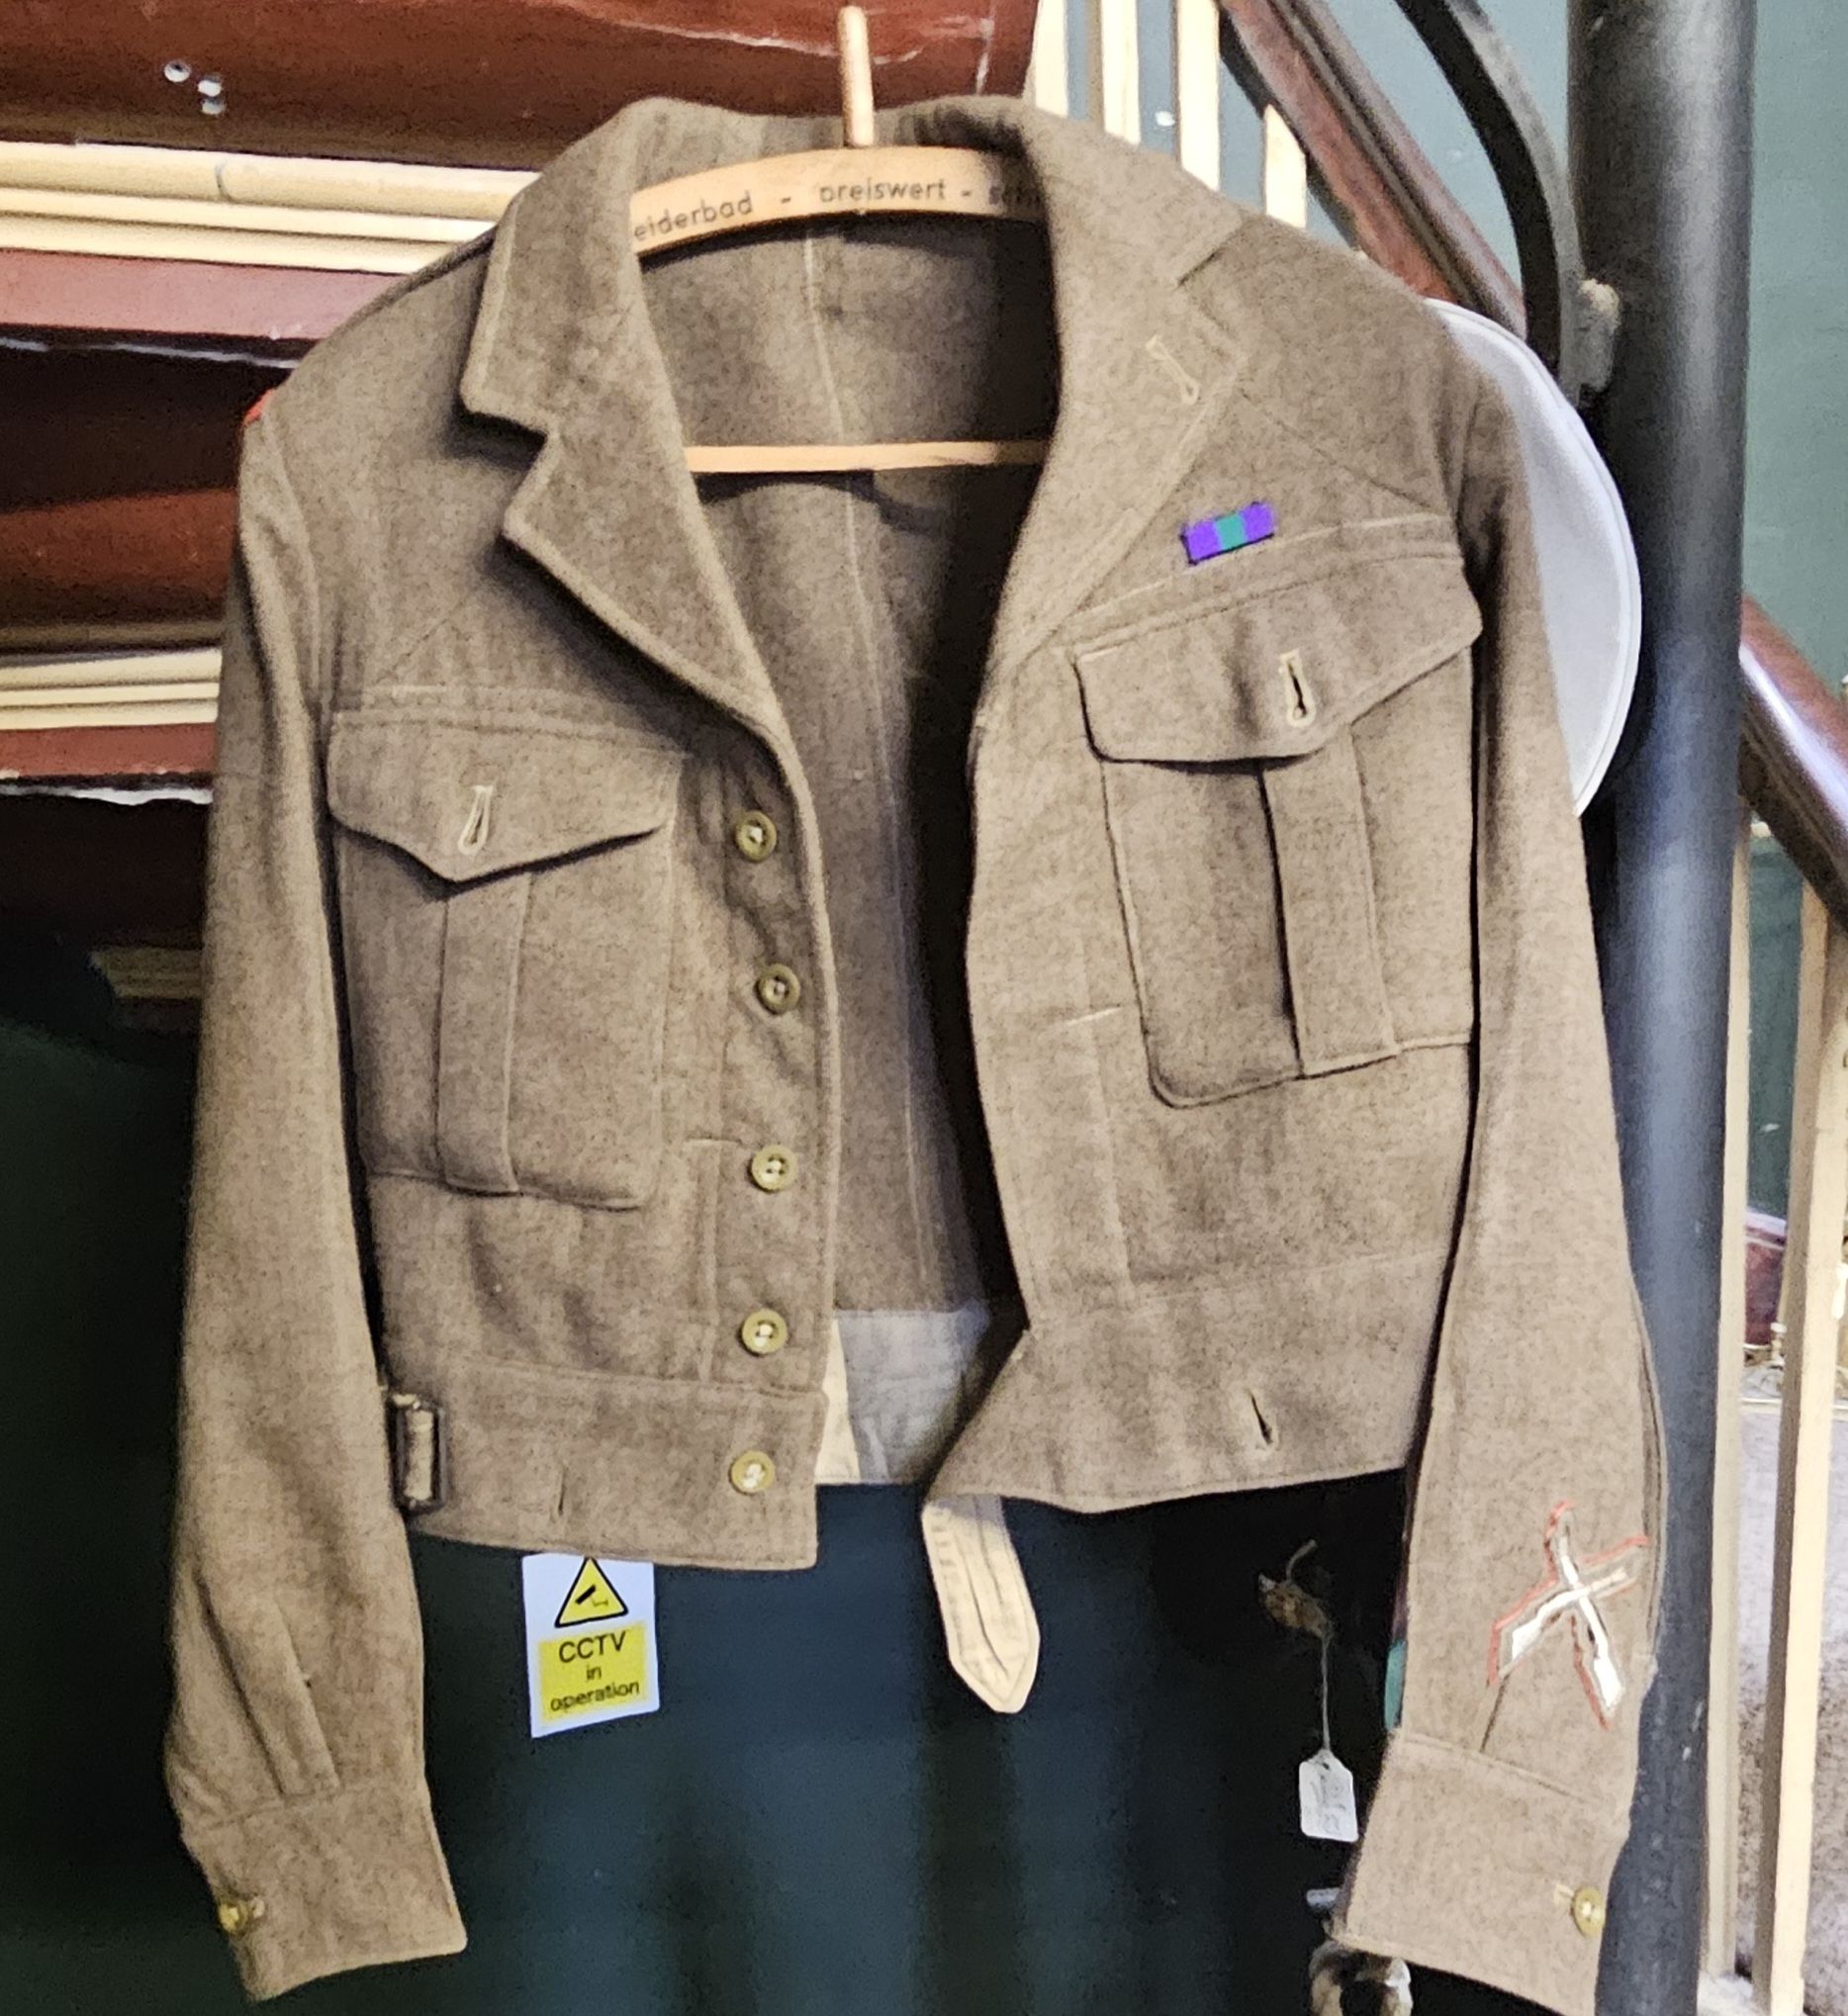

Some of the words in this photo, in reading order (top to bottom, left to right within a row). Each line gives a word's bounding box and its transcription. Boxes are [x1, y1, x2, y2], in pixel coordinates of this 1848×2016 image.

[559, 1630, 626, 1663] CCTV
[586, 1664, 601, 1681] in
[550, 1681, 640, 1713] operation
